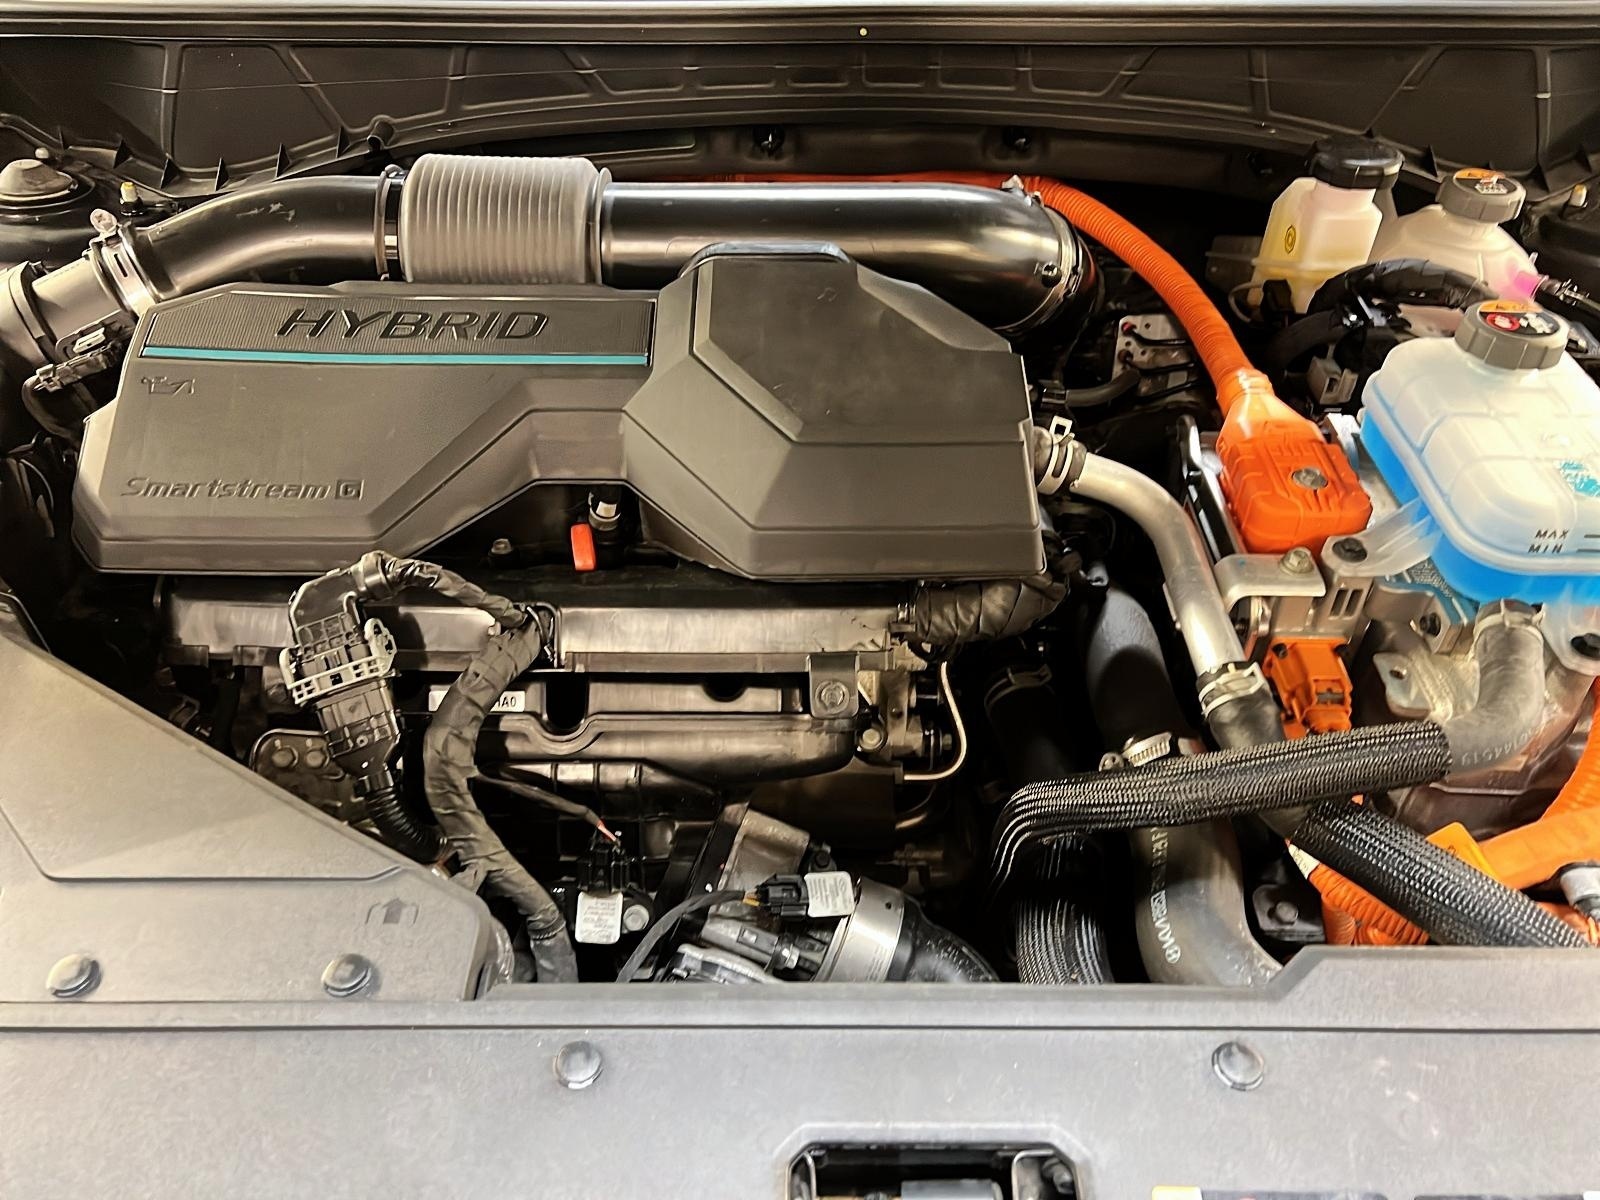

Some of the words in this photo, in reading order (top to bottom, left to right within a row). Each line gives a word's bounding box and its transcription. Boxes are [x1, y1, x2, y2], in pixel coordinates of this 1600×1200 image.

[275, 308, 549, 340] HYBRID
[120, 477, 331, 499] Smartstream
[1534, 529, 1569, 540] MAX
[1527, 543, 1563, 554] MIN
